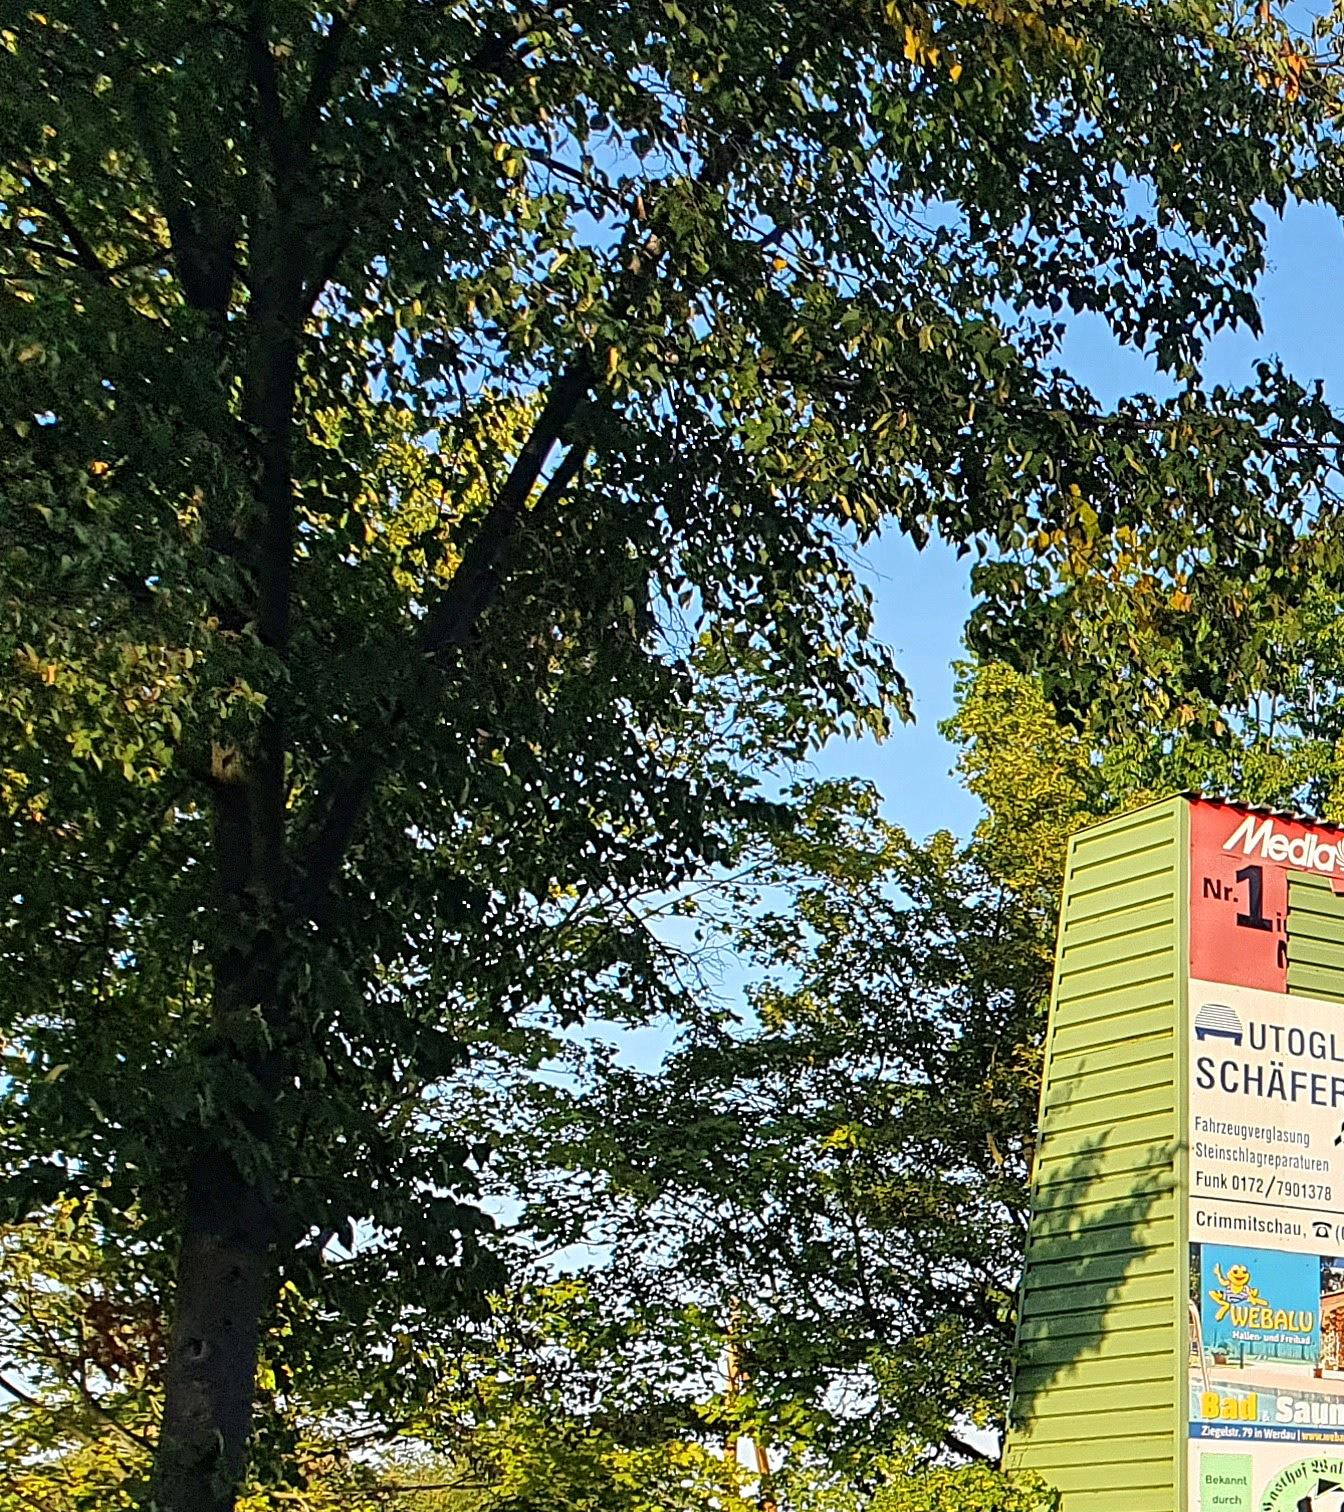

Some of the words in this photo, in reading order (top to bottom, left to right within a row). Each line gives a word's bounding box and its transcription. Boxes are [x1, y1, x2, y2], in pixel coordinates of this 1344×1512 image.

[1222, 816, 1337, 871] Media
[1203, 877, 1238, 903] Nr.
[1235, 864, 1273, 932] 1
[1195, 1116, 1310, 1148] Fahrzeugverglasung
[1195, 1143, 1329, 1173] Steinschlagreparaturen
[1195, 1171, 1227, 1191] Funk
[1232, 1174, 1332, 1201] 0172/7901378
[1196, 1211, 1307, 1239] Crimmitschau,
[1229, 1303, 1314, 1333] WEBALU
[1263, 1333, 1280, 1343] und
[1281, 1333, 1312, 1345] Freibad
[1201, 1391, 1258, 1421] Bad
[1201, 1425, 1241, 1439] Ziegelstr.
[1242, 1427, 1253, 1437] 79
[1254, 1428, 1262, 1438] in
[1262, 1429, 1296, 1440] Werdau
[1205, 1474, 1247, 1487] Bekannt
[1212, 1494, 1242, 1506] durch
